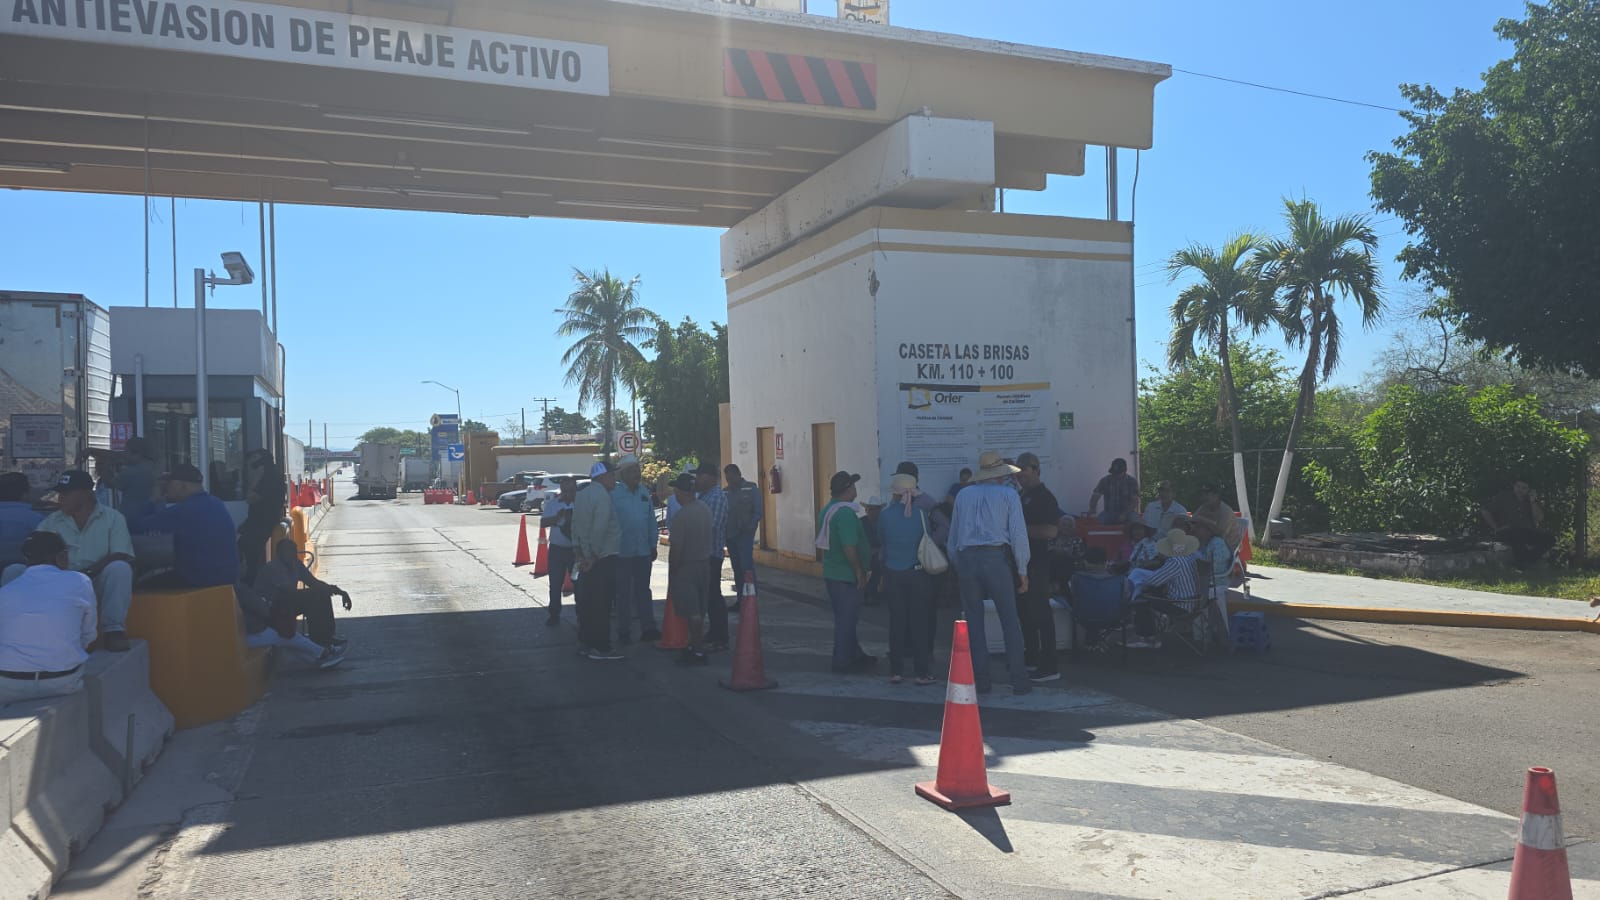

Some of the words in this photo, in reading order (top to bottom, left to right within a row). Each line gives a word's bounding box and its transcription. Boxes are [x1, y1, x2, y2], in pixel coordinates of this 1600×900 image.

[12, 0, 275, 49] ANTIEVASION
[289, 18, 336, 56] DE
[349, 24, 455, 69] PEAJE
[467, 39, 582, 83] ACTIVO
[898, 343, 952, 360] CASETA
[955, 344, 980, 360] LAS
[983, 345, 1030, 361] BRISAS
[917, 363, 945, 380] KM.
[949, 364, 975, 380] 110
[977, 366, 986, 378] +
[989, 364, 1014, 380] 100
[624, 436, 635, 449] E
